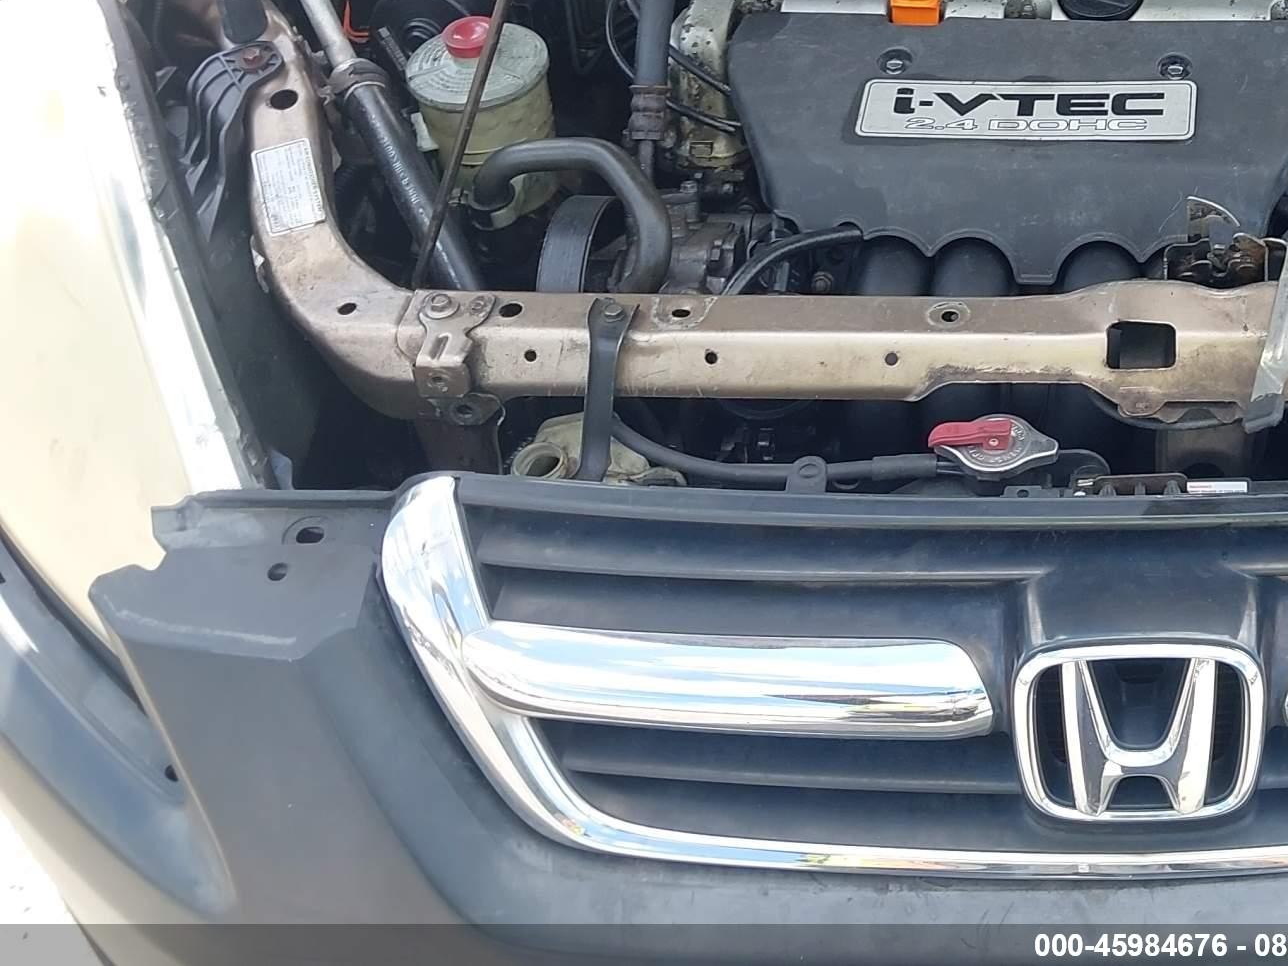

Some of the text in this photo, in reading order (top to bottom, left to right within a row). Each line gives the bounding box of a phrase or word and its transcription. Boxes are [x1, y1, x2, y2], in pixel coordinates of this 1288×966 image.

[893, 87, 1165, 117] i-VTEC
[904, 117, 1148, 132] 2.4 DOHC
